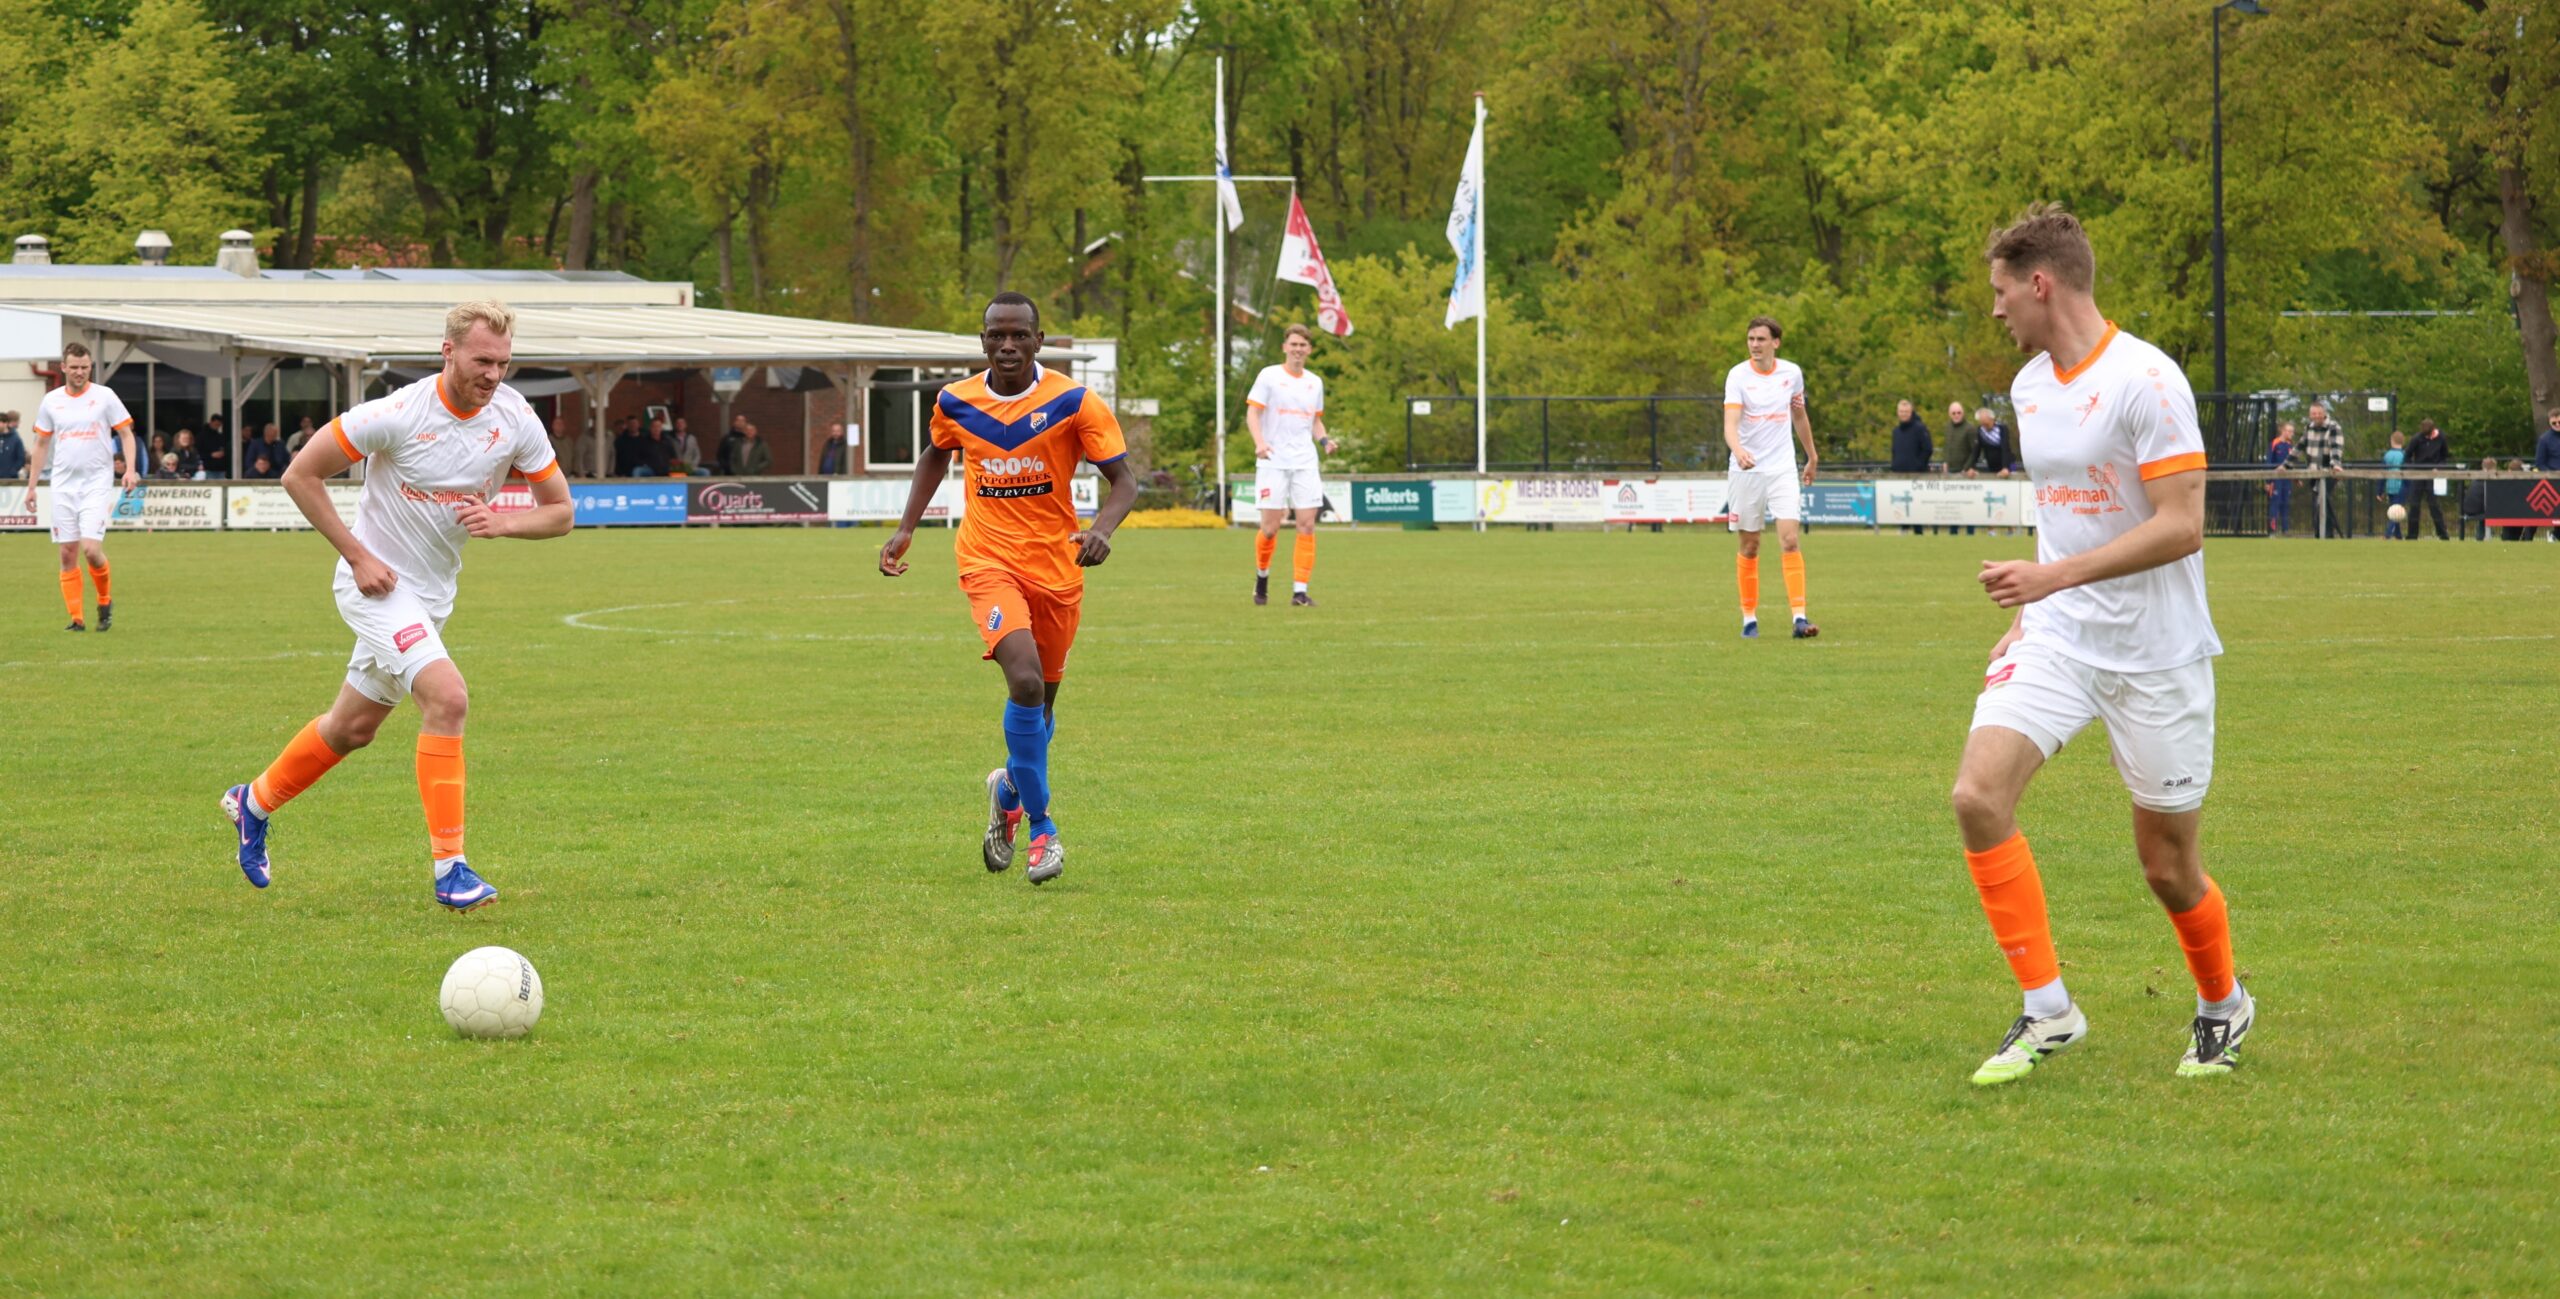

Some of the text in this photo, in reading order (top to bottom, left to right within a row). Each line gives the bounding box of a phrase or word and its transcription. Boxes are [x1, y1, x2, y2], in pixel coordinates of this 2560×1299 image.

[980, 455, 1044, 475] 100%
[976, 472, 1052, 484] HYPOTHEEK
[986, 485, 1045, 497] SERVICE
[1365, 487, 1420, 504] Folkerts
[1517, 480, 1600, 498] MEIJER RODEN
[2047, 485, 2110, 506] Spijkerman
[707, 490, 764, 511] Quarts
[118, 502, 207, 517] GLASHANDEL
